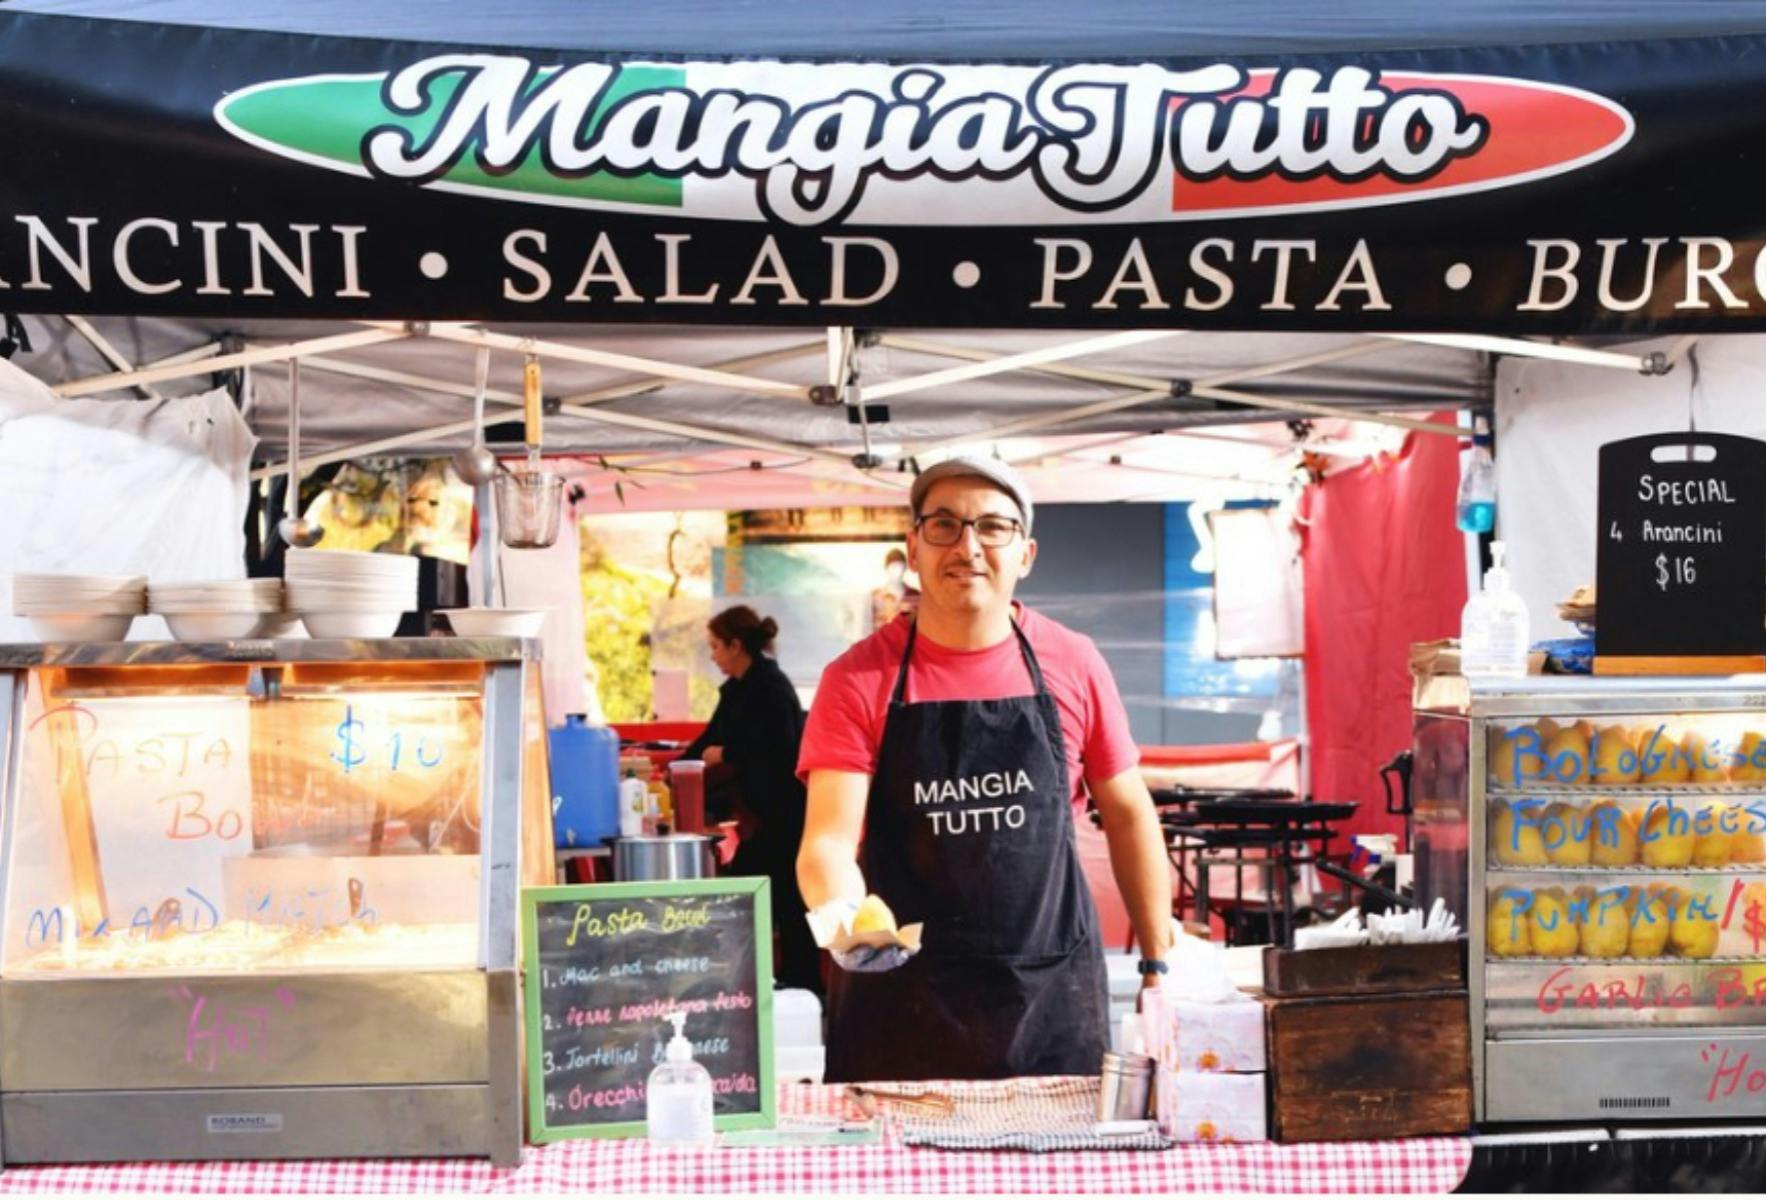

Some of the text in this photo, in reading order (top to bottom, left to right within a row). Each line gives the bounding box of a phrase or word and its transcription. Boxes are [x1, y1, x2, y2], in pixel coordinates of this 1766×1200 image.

[0, 214, 1766, 312] NCINI SALAD PASTA BUR
[1610, 520, 1723, 543] 4 Arancini
[1656, 553, 1696, 591] $16
[913, 769, 1035, 804] MANGIA
[926, 804, 1026, 835] TUTTO
[566, 904, 648, 946] Pasta
[559, 966, 600, 985] Mac
[609, 959, 643, 978] and
